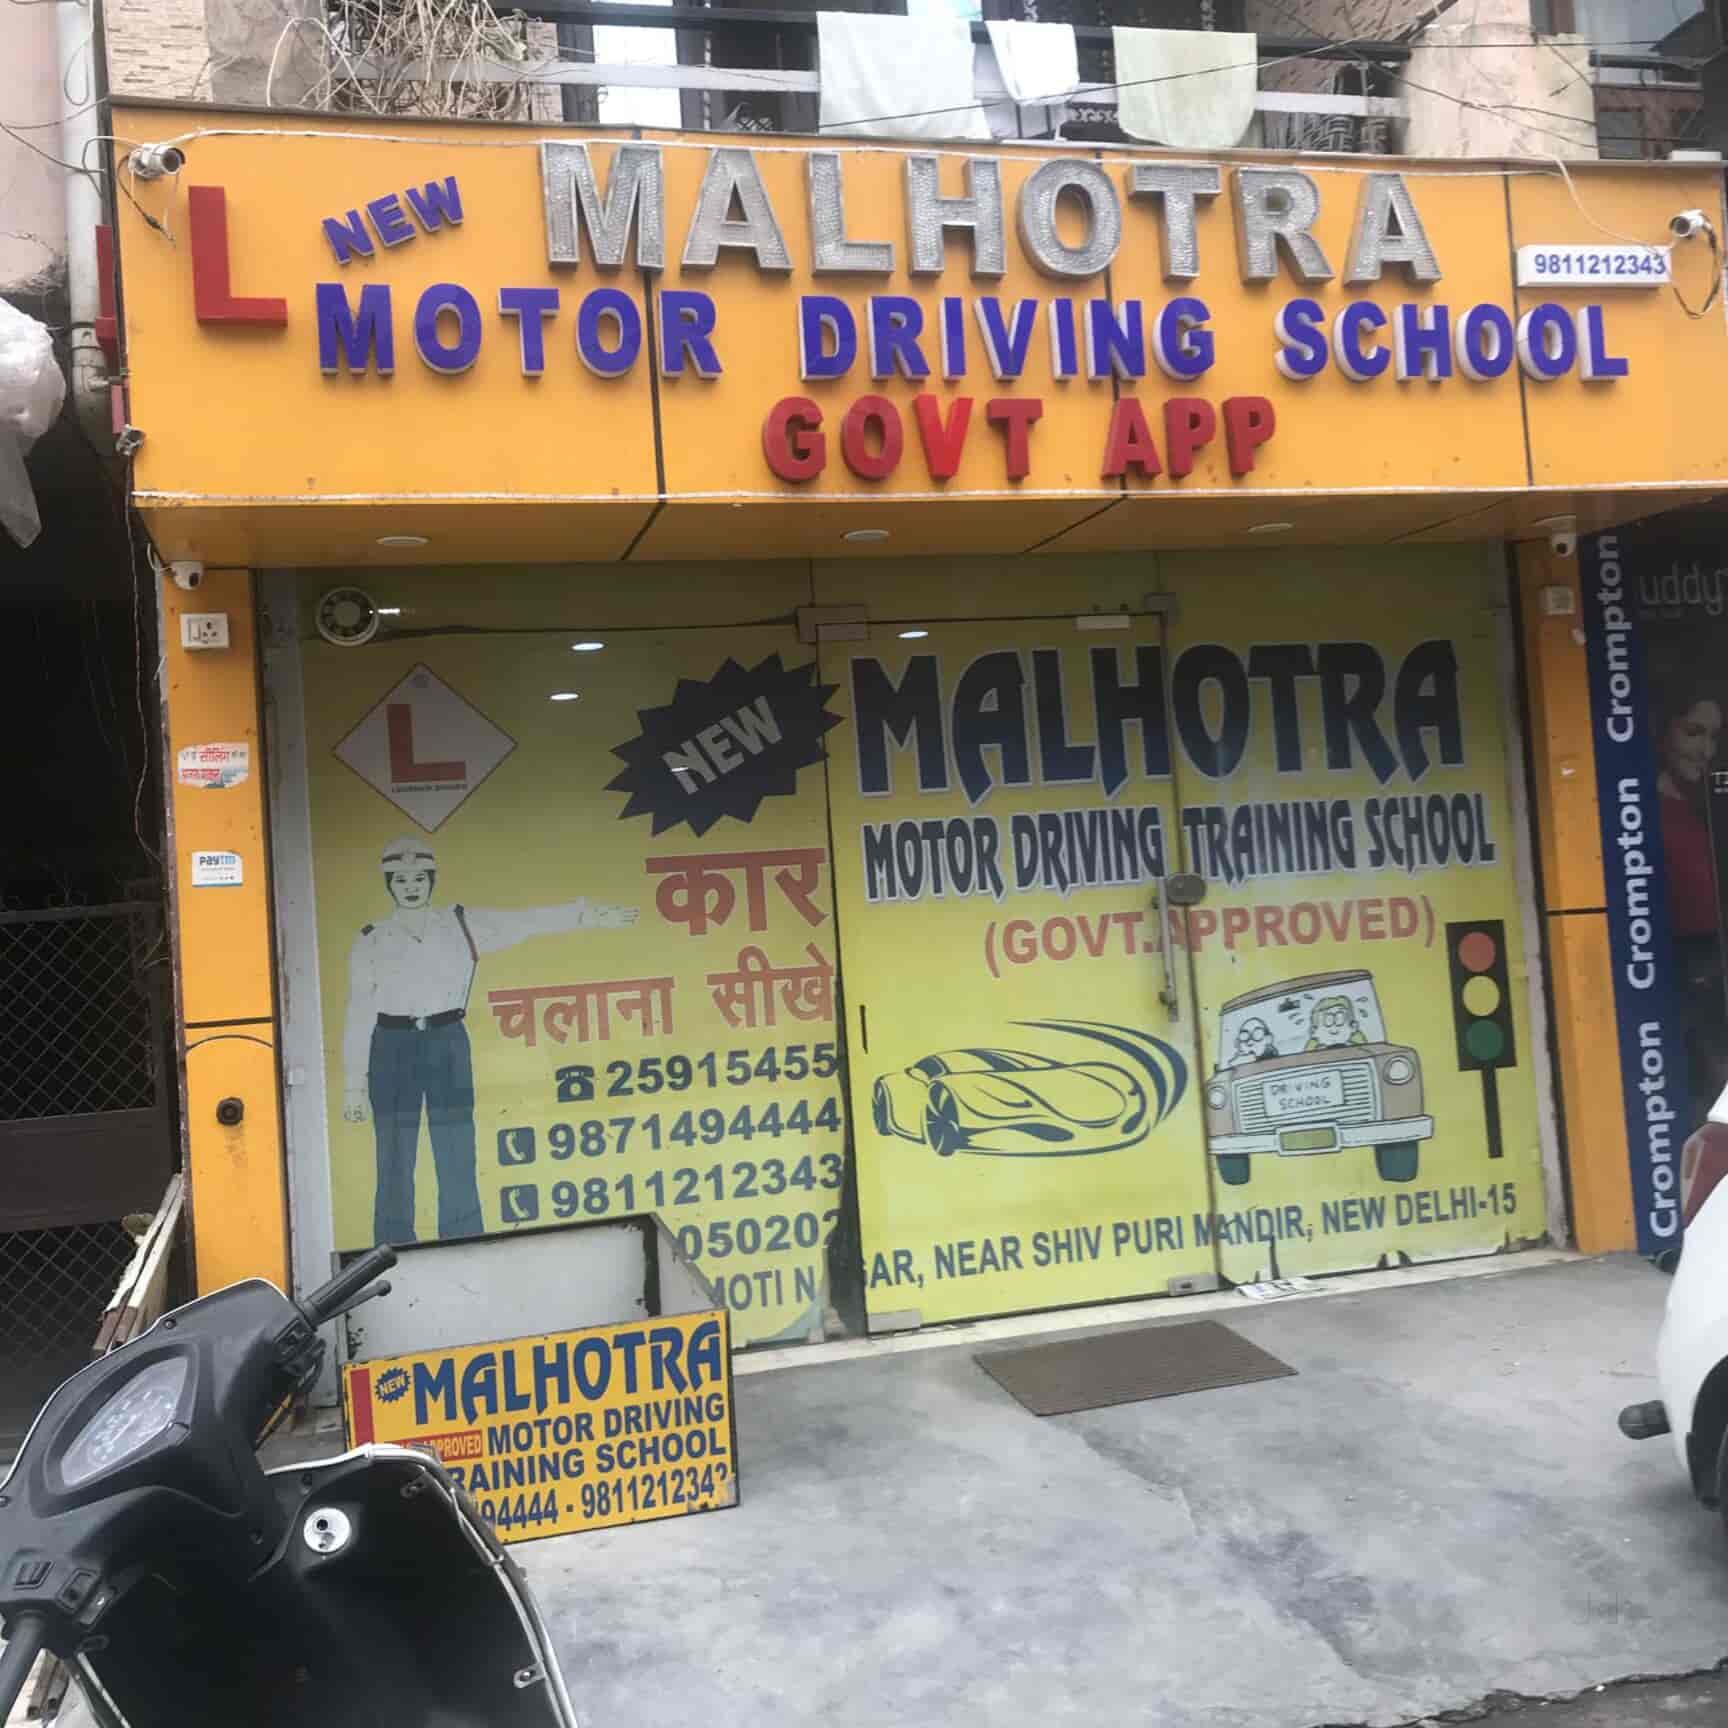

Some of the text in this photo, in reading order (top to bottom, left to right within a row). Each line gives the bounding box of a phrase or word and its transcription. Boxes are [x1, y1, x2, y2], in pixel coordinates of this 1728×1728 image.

[188, 185, 288, 328] L
[322, 141, 1441, 285] NEW MALHOTRA
[1534, 253, 1666, 275] 9811212343
[315, 282, 1629, 383] MOTOR DRIVING SCHOOL
[762, 393, 1276, 483] GOVT APP
[1598, 534, 1635, 743] Crompton
[662, 696, 783, 796] NEW
[849, 638, 1466, 807] MALHOTRA
[645, 847, 831, 936] कार
[862, 793, 1497, 902] MOTOR DRIVING TRAINING SCHOOL
[1617, 777, 1656, 990] Crompton
[488, 976, 675, 1048] चलाना
[606, 1042, 840, 1098] 25915455
[547, 1097, 841, 1161] 9871494444
[1637, 1021, 1679, 1238] Crompton
[551, 1152, 843, 1218] 9811212343
[935, 1237, 1024, 1278] NEAR
[1032, 1225, 1103, 1267] SHIV
[1114, 1215, 1184, 1257] PURI
[1320, 1195, 1386, 1235] NEW
[1394, 1182, 1517, 1227] DELHI-15
[413, 1320, 723, 1426] MALHOTRA
[446, 1428, 727, 1494] RAINING SCHOOL
[488, 1412, 595, 1457] MOTOR
[603, 1392, 725, 1436] DRIVING
[477, 1490, 559, 1532] 94444
